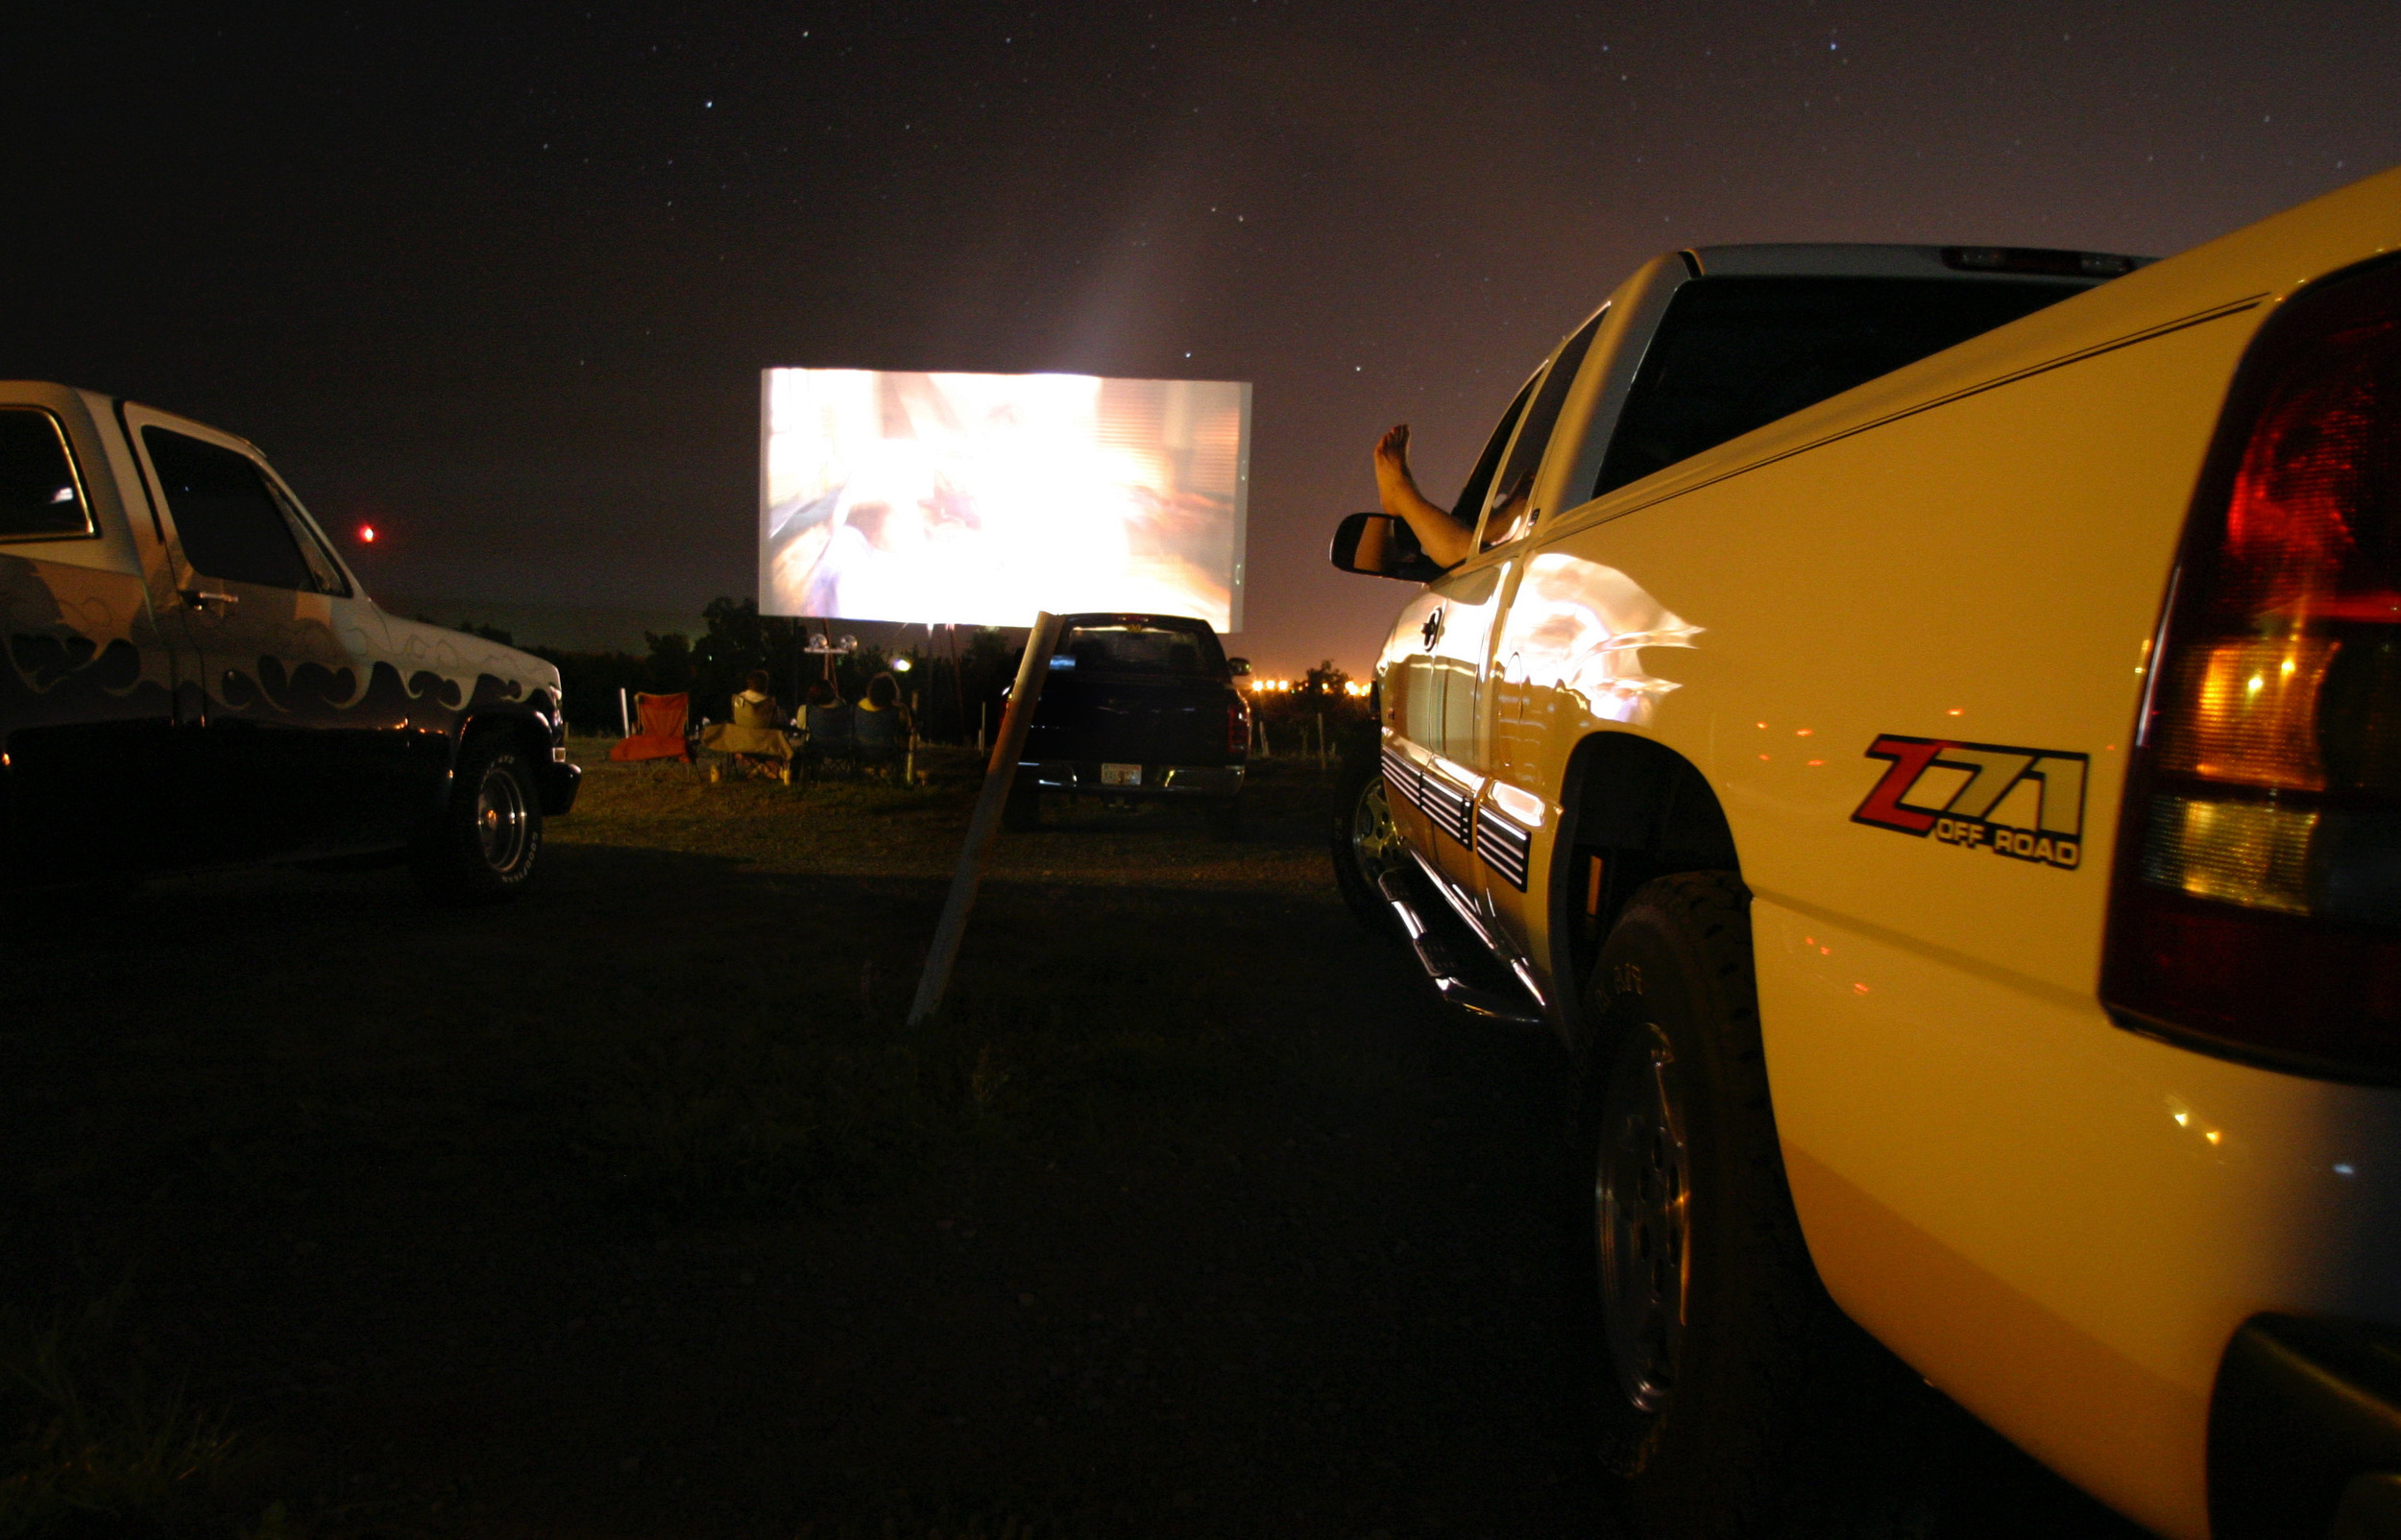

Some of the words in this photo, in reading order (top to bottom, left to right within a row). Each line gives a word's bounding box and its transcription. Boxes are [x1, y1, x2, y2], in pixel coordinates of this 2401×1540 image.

[1852, 734, 2089, 839] Z71
[501, 831, 539, 882] GOOD
[1936, 817, 1986, 848] OFF
[1994, 829, 2081, 868] ROAD
